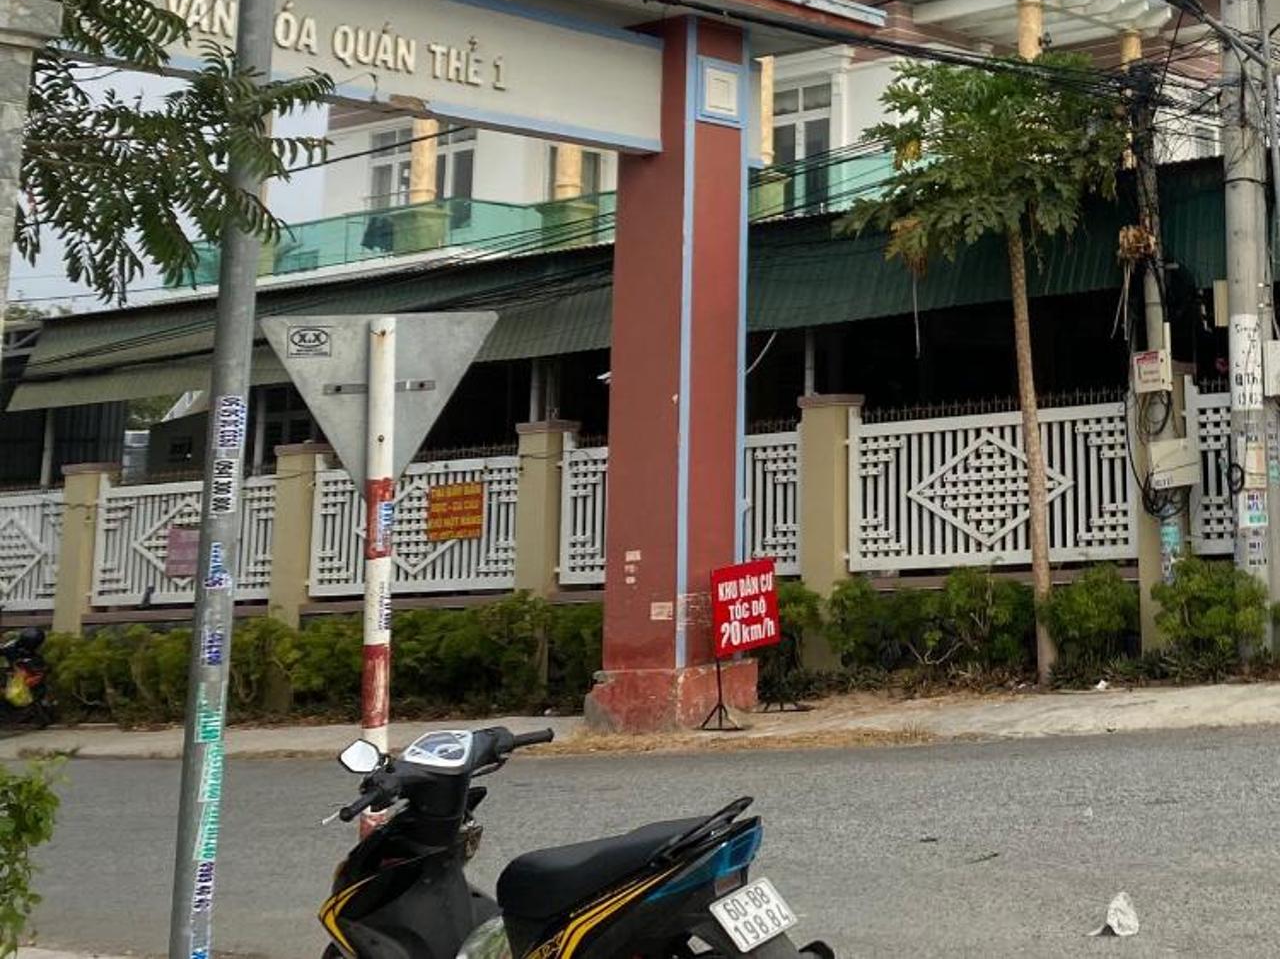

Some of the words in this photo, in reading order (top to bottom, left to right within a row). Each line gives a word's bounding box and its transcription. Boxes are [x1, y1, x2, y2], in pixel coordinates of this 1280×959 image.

[273, 0, 318, 55] ÓA
[332, 21, 416, 74] QUÁN
[493, 56, 506, 91] 1
[718, 580, 738, 601] KHU
[739, 574, 759, 598] DÂN
[728, 598, 750, 621] TỐC
